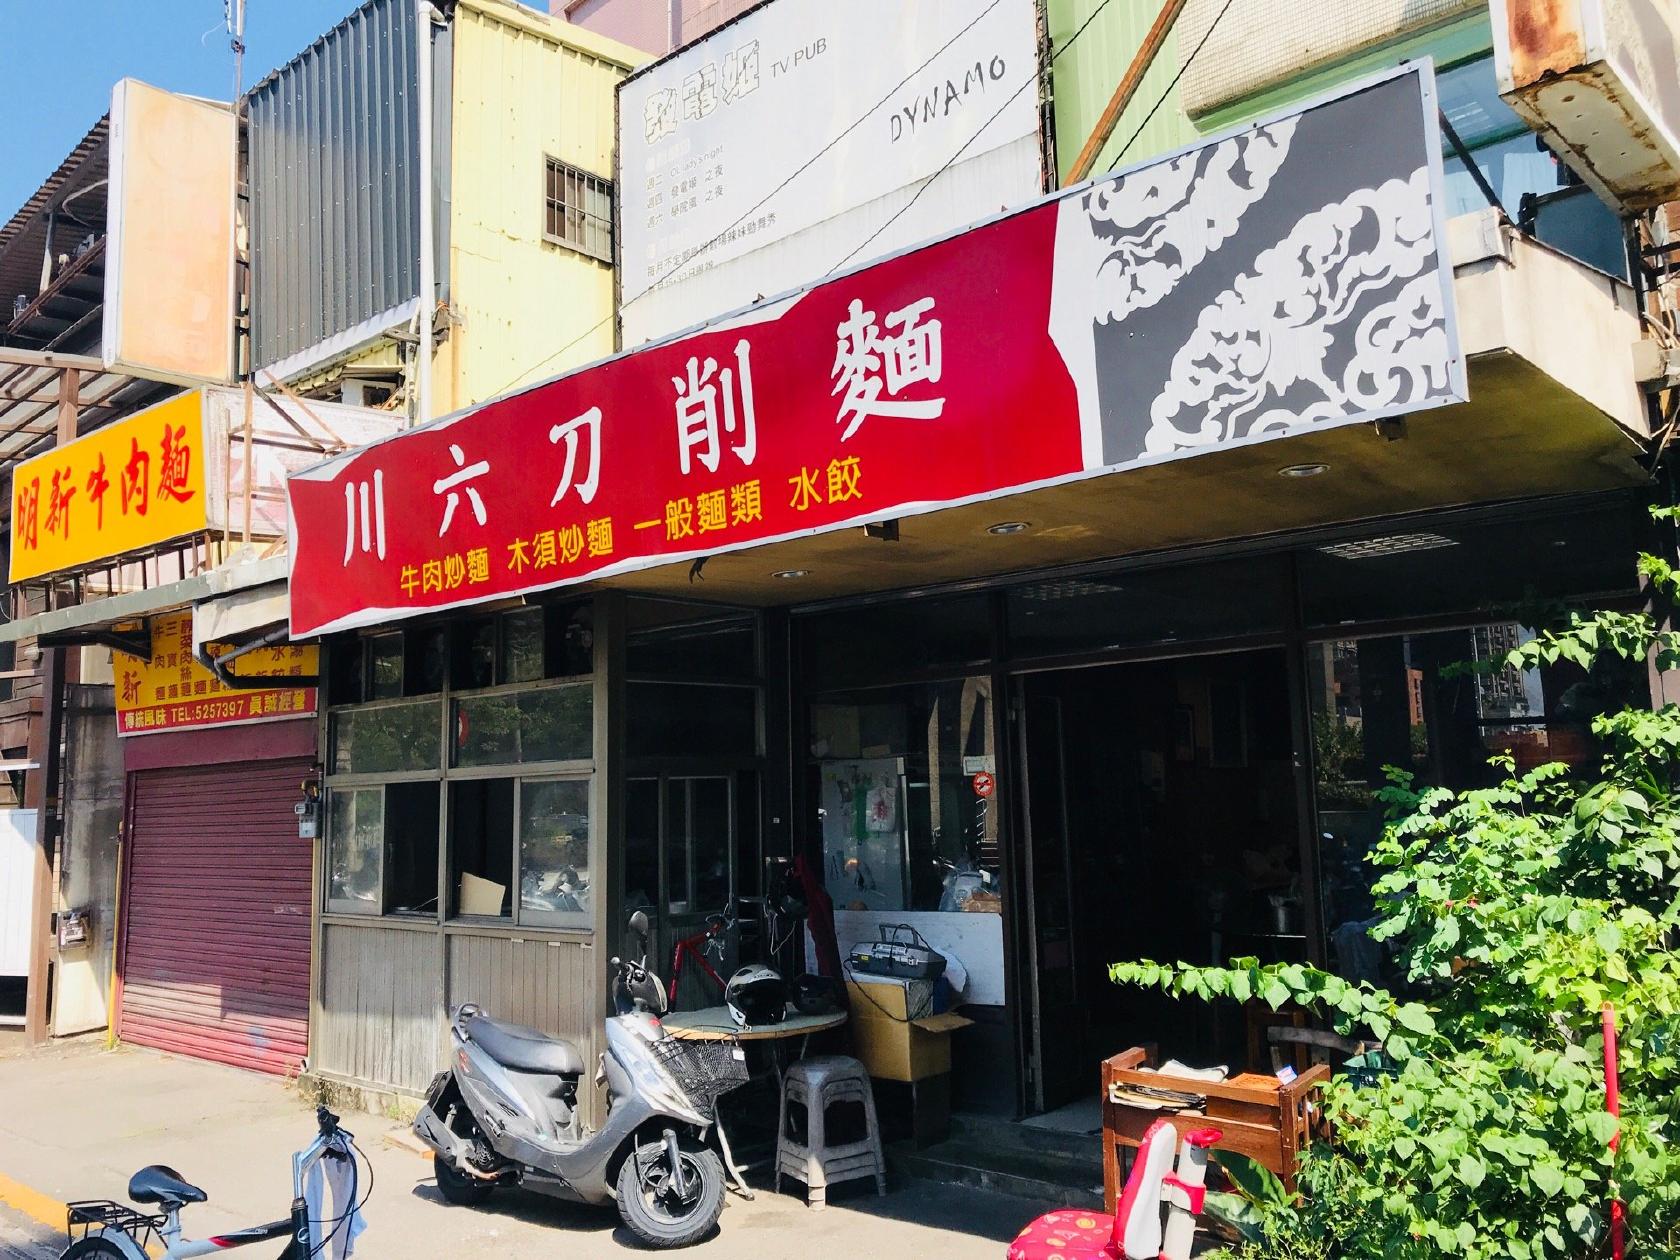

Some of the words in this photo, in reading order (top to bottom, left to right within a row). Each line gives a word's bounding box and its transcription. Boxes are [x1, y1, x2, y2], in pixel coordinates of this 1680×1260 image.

[769, 56, 790, 79] TV
[793, 37, 828, 67] PUB
[890, 54, 1007, 144] DYNAMO
[344, 296, 945, 567] 川六刀削麵
[17, 423, 196, 551] 明新牛肉麵
[400, 546, 490, 599] 牛肉炒麵
[507, 516, 614, 575] 木須炒麵
[633, 479, 763, 541] 一般麵類
[788, 456, 863, 512] 水餃
[125, 708, 167, 730] 傳統風味
[172, 699, 245, 722] TEL:5257397
